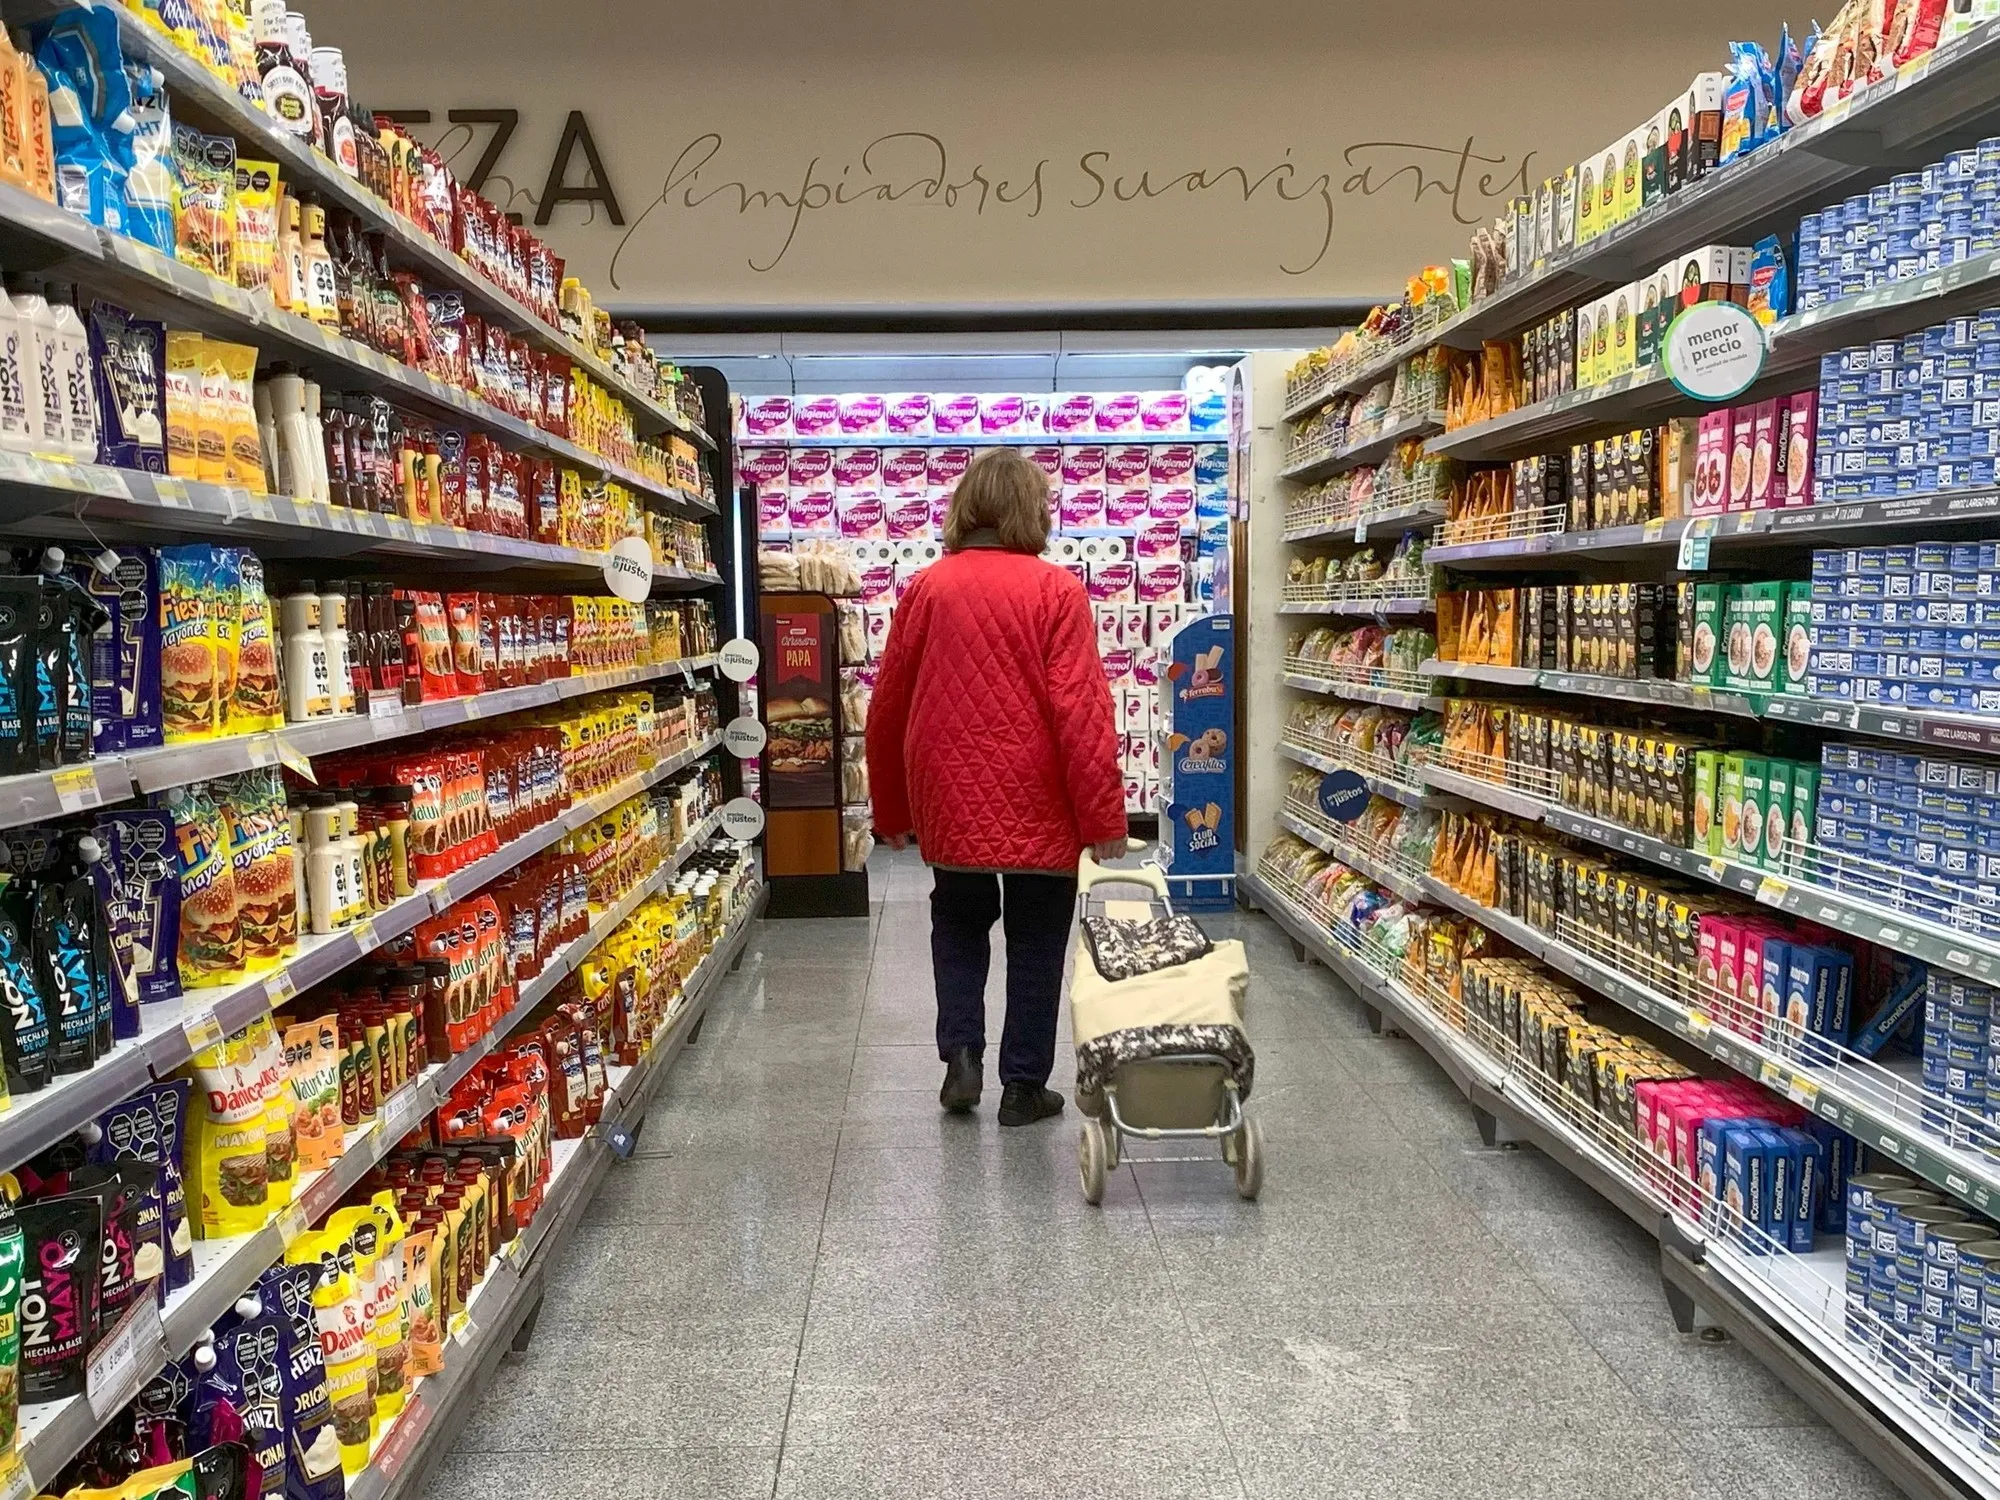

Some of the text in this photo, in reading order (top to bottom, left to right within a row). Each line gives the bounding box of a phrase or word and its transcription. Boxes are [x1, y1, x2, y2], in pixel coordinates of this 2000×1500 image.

[372, 109, 626, 227] ZA
[609, 131, 1049, 290] limpiadores
[1687, 321, 1740, 347] menor
[1692, 338, 1742, 366] precio
[1705, 361, 1723, 370] unidad
[1730, 353, 1748, 363] medida
[7, 336, 21, 405] MAYO
[45, 343, 61, 410] MAYO
[40, 361, 52, 409] NOT
[75, 351, 88, 416] MAYO
[67, 368, 80, 415] NOT
[750, 407, 789, 420] Higienol
[796, 406, 836, 421] Higienol
[841, 406, 881, 420] Higienol
[889, 405, 928, 419] Higienol
[936, 404, 976, 418] Higienol
[983, 407, 1022, 420] Higienol
[1054, 405, 1092, 419] Higienol
[1100, 405, 1139, 419] Higienol
[1146, 404, 1186, 419] Higienol
[744, 460, 784, 473] Higienol
[791, 459, 828, 472] Higienol
[838, 459, 875, 473] Higienol
[887, 459, 926, 473] Higienol
[929, 457, 967, 471] Higienol
[1065, 458, 1103, 471] Higienol
[1108, 458, 1148, 471] Higienol
[1153, 457, 1191, 470] Higienol
[791, 501, 832, 514] Higienol
[1063, 499, 1102, 512] Higienol
[1109, 499, 1148, 512] Higienol
[1153, 498, 1191, 511] Higienol
[841, 509, 881, 523] Higienol
[888, 509, 928, 523] Higienol
[1139, 529, 1178, 542] Higienol
[614, 554, 639, 567] precios
[618, 560, 649, 582] justos
[1091, 573, 1129, 586] Higienol
[1141, 573, 1179, 586] Higienol
[729, 656, 753, 665] justos
[786, 649, 811, 667] PAPA
[2, 718, 21, 728] BASE
[0, 727, 18, 737] NTAS
[734, 733, 759, 742] justos
[1933, 727, 1981, 742] ARROZ LARGO FINO
[1334, 784, 1363, 806] justos
[731, 814, 757, 825] justos
[1193, 829, 1213, 843] CLUB
[48, 949, 77, 1016] NOT
[101, 1237, 121, 1288] NO
[40, 1240, 75, 1341] MAYO
[103, 1281, 125, 1299] HECHA
[20, 1277, 51, 1347] NOT
[24, 1336, 83, 1359] HECHA A BASE
[31, 1346, 81, 1366] DE PLANTAS
[328, 1366, 367, 1392] MAYO
